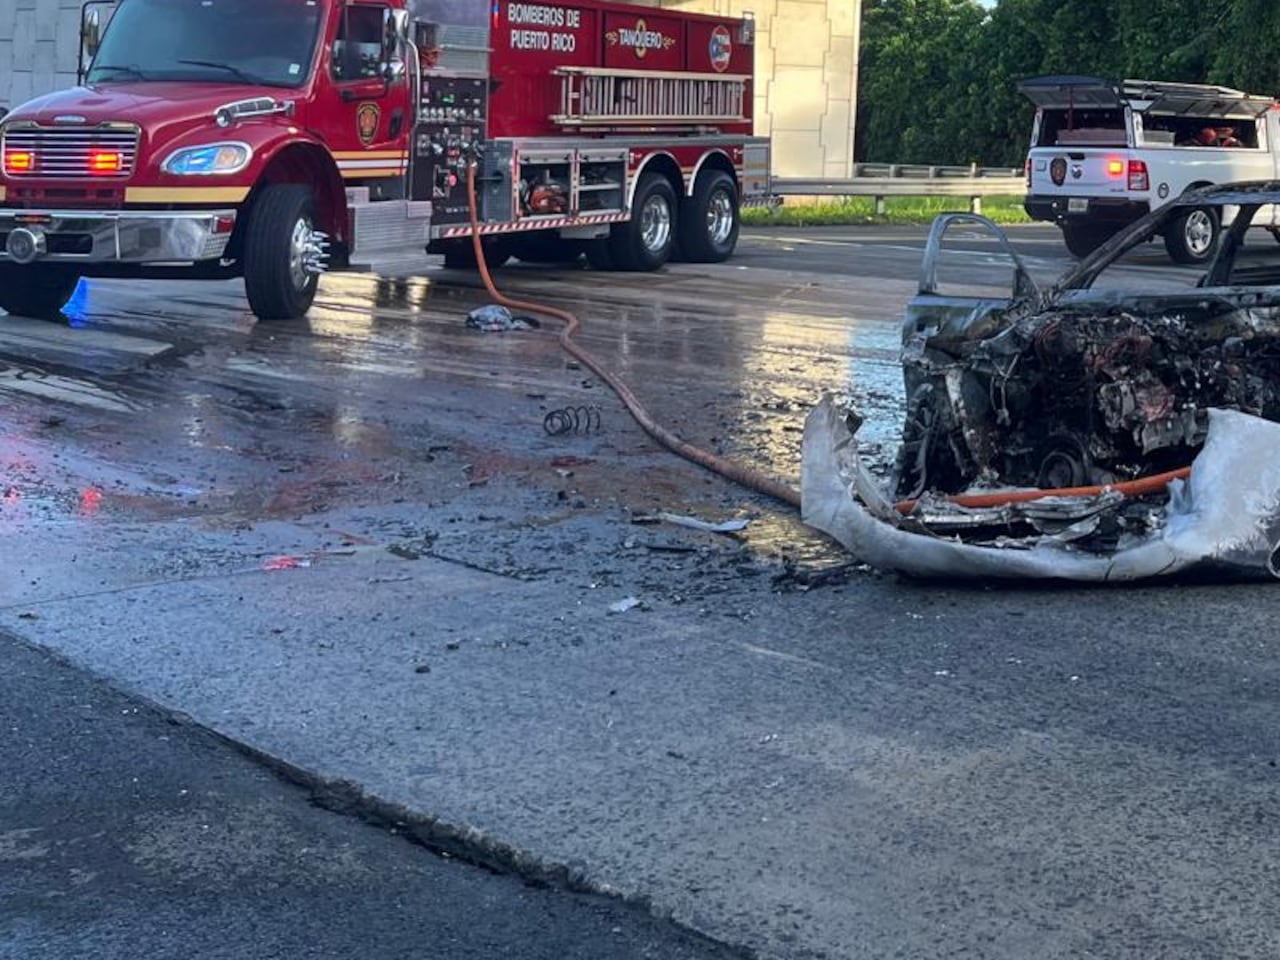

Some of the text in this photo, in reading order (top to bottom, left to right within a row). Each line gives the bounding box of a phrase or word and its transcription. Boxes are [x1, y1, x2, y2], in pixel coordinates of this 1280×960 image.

[507, 3, 580, 28] BOMBEROS DE
[511, 29, 576, 52] PUERTO RICO
[618, 28, 662, 49] TANQUERO
